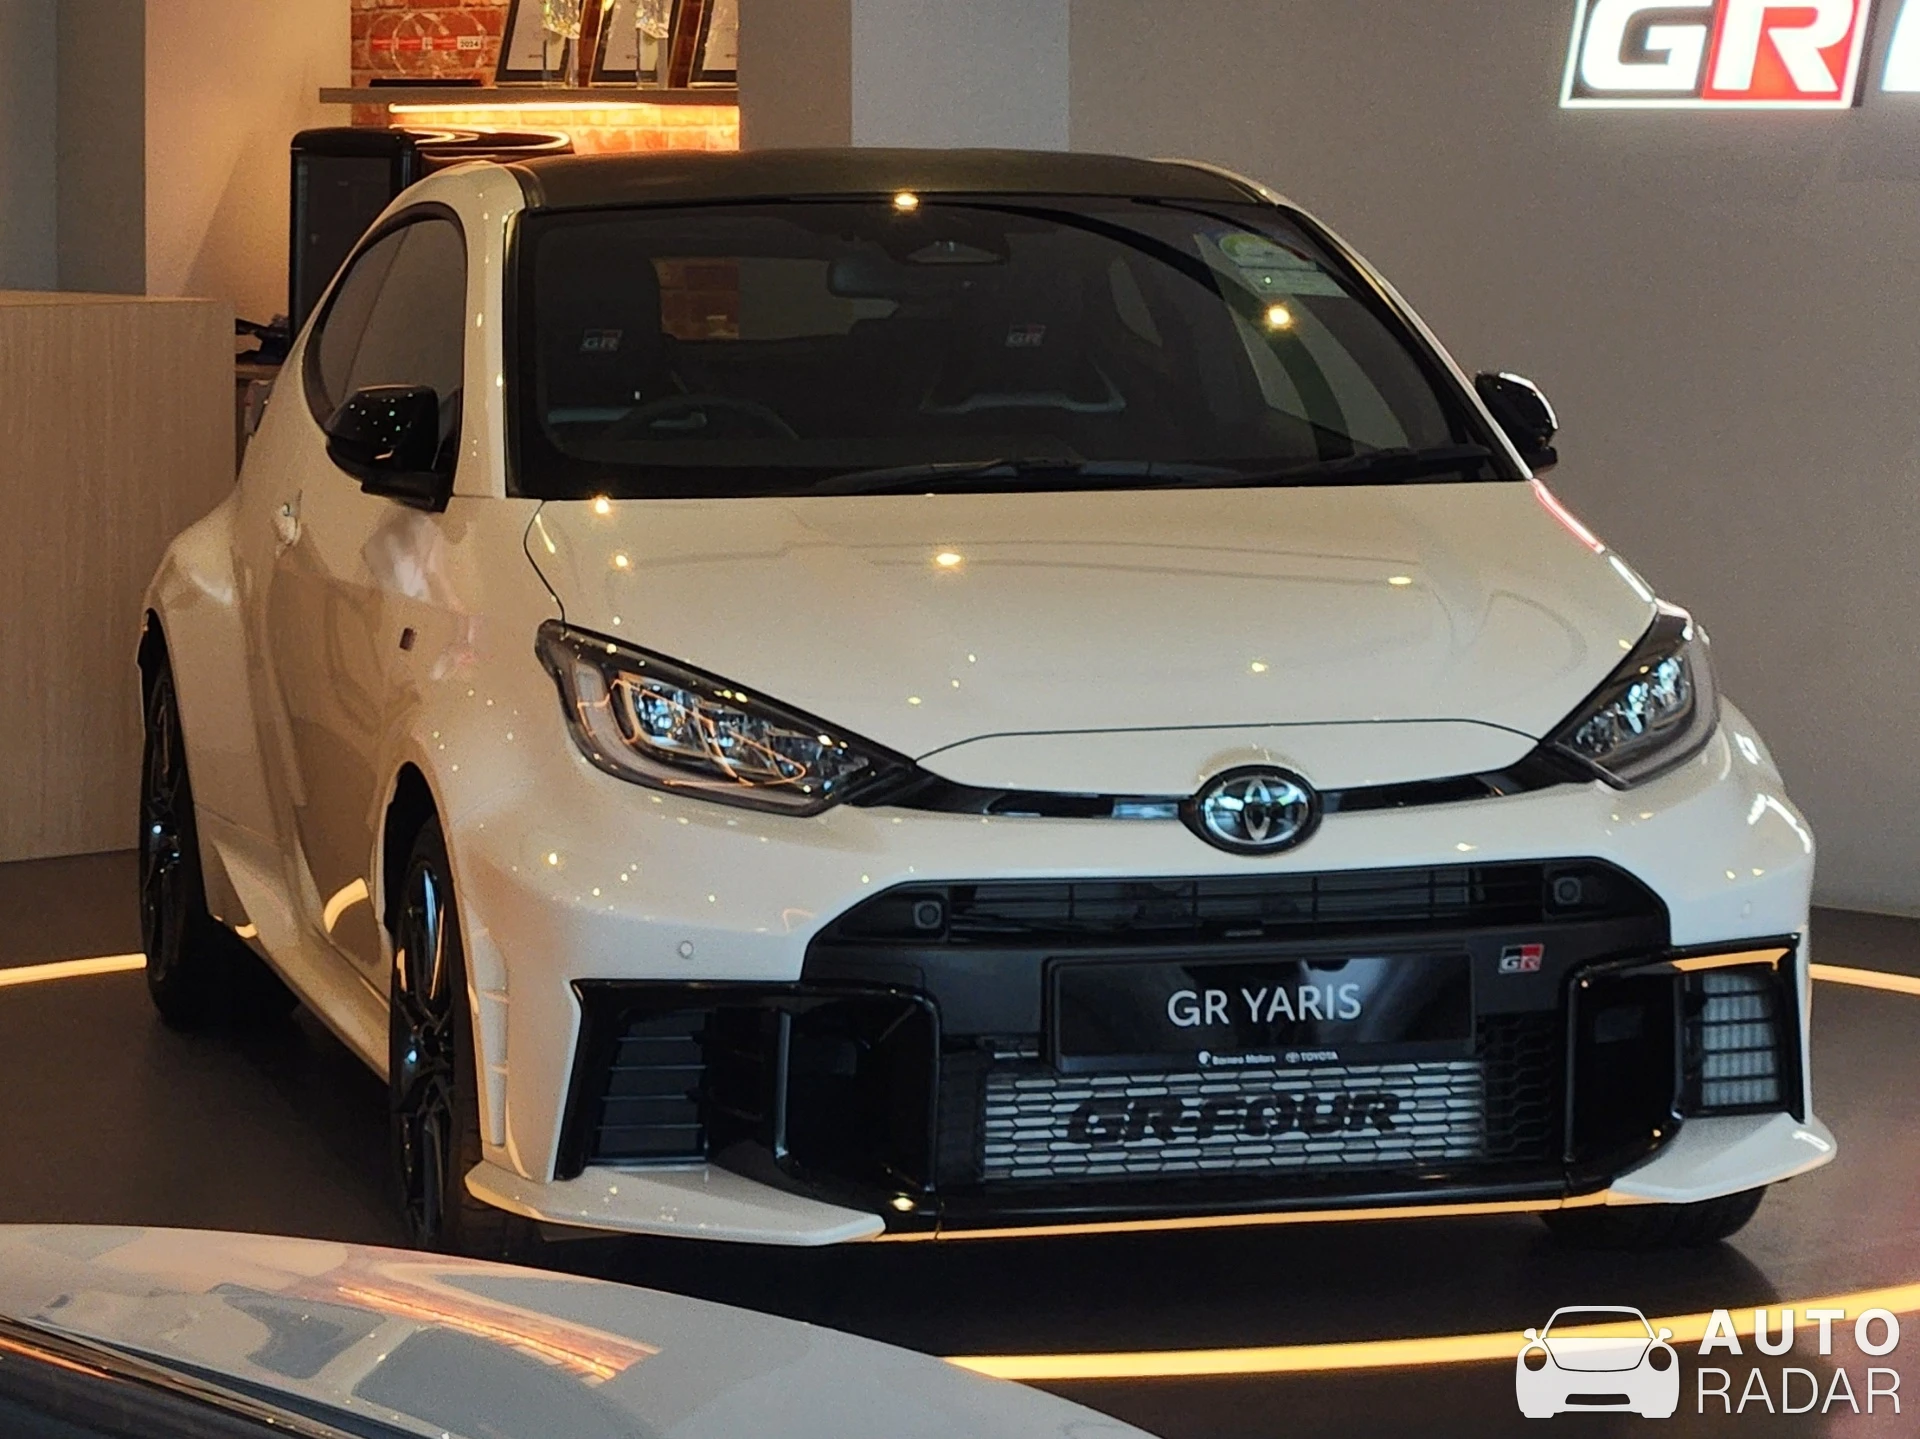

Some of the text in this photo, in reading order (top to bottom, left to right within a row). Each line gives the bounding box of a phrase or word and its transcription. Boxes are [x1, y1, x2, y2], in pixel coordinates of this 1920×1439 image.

[1581, 0, 1853, 91] GR
[1501, 954, 1541, 971] GR
[1167, 983, 1362, 1027] GR YARIS
[1300, 1051, 1339, 1061] TOYOTA
